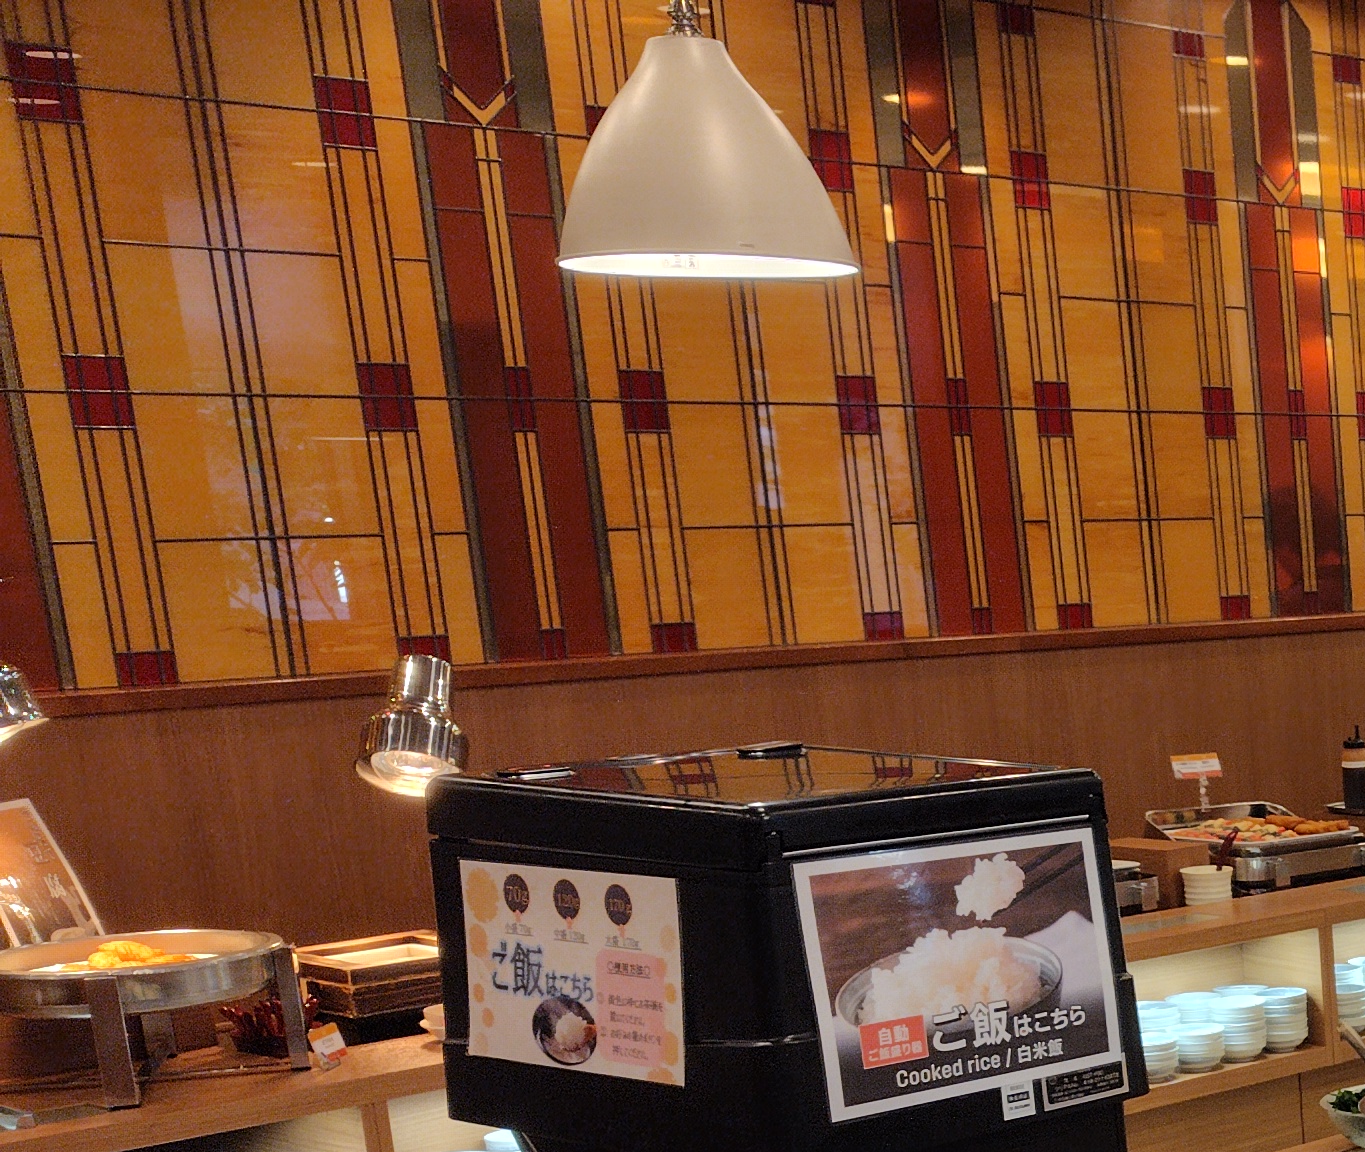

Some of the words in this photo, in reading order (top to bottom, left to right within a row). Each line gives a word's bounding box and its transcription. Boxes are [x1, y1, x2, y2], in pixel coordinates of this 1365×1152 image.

[492, 941, 594, 1002] ご飯はこちら
[878, 1024, 909, 1046] 自動
[932, 1000, 1086, 1052] ご飯はこちら
[896, 1057, 964, 1088] Cooked
[967, 1054, 1001, 1074] rice
[1017, 1038, 1064, 1064] 白米飯
